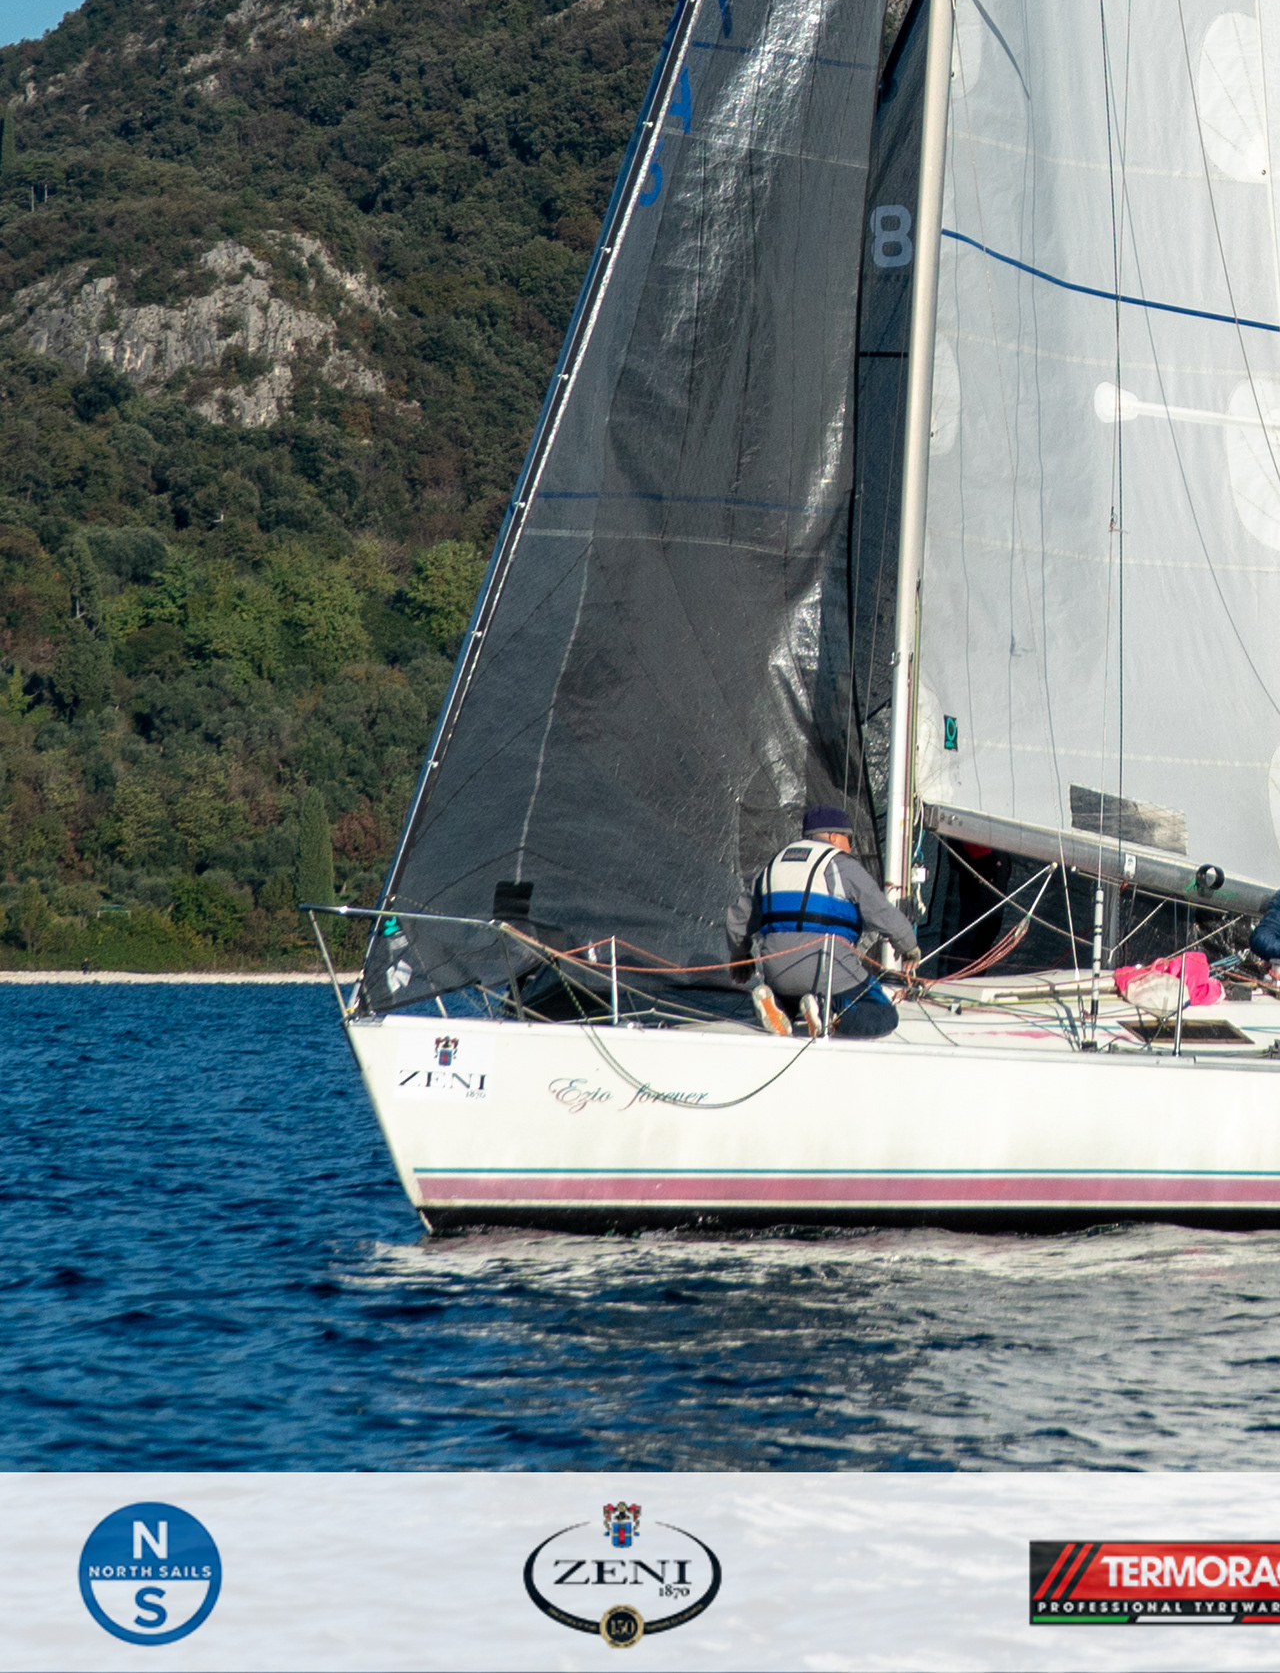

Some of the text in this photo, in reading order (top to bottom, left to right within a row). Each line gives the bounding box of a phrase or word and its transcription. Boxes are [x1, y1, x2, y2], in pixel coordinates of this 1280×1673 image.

[399, 1070, 486, 1090] ZENI
[466, 1089, 486, 1099] 1870
[618, 1082, 709, 1111] forever
